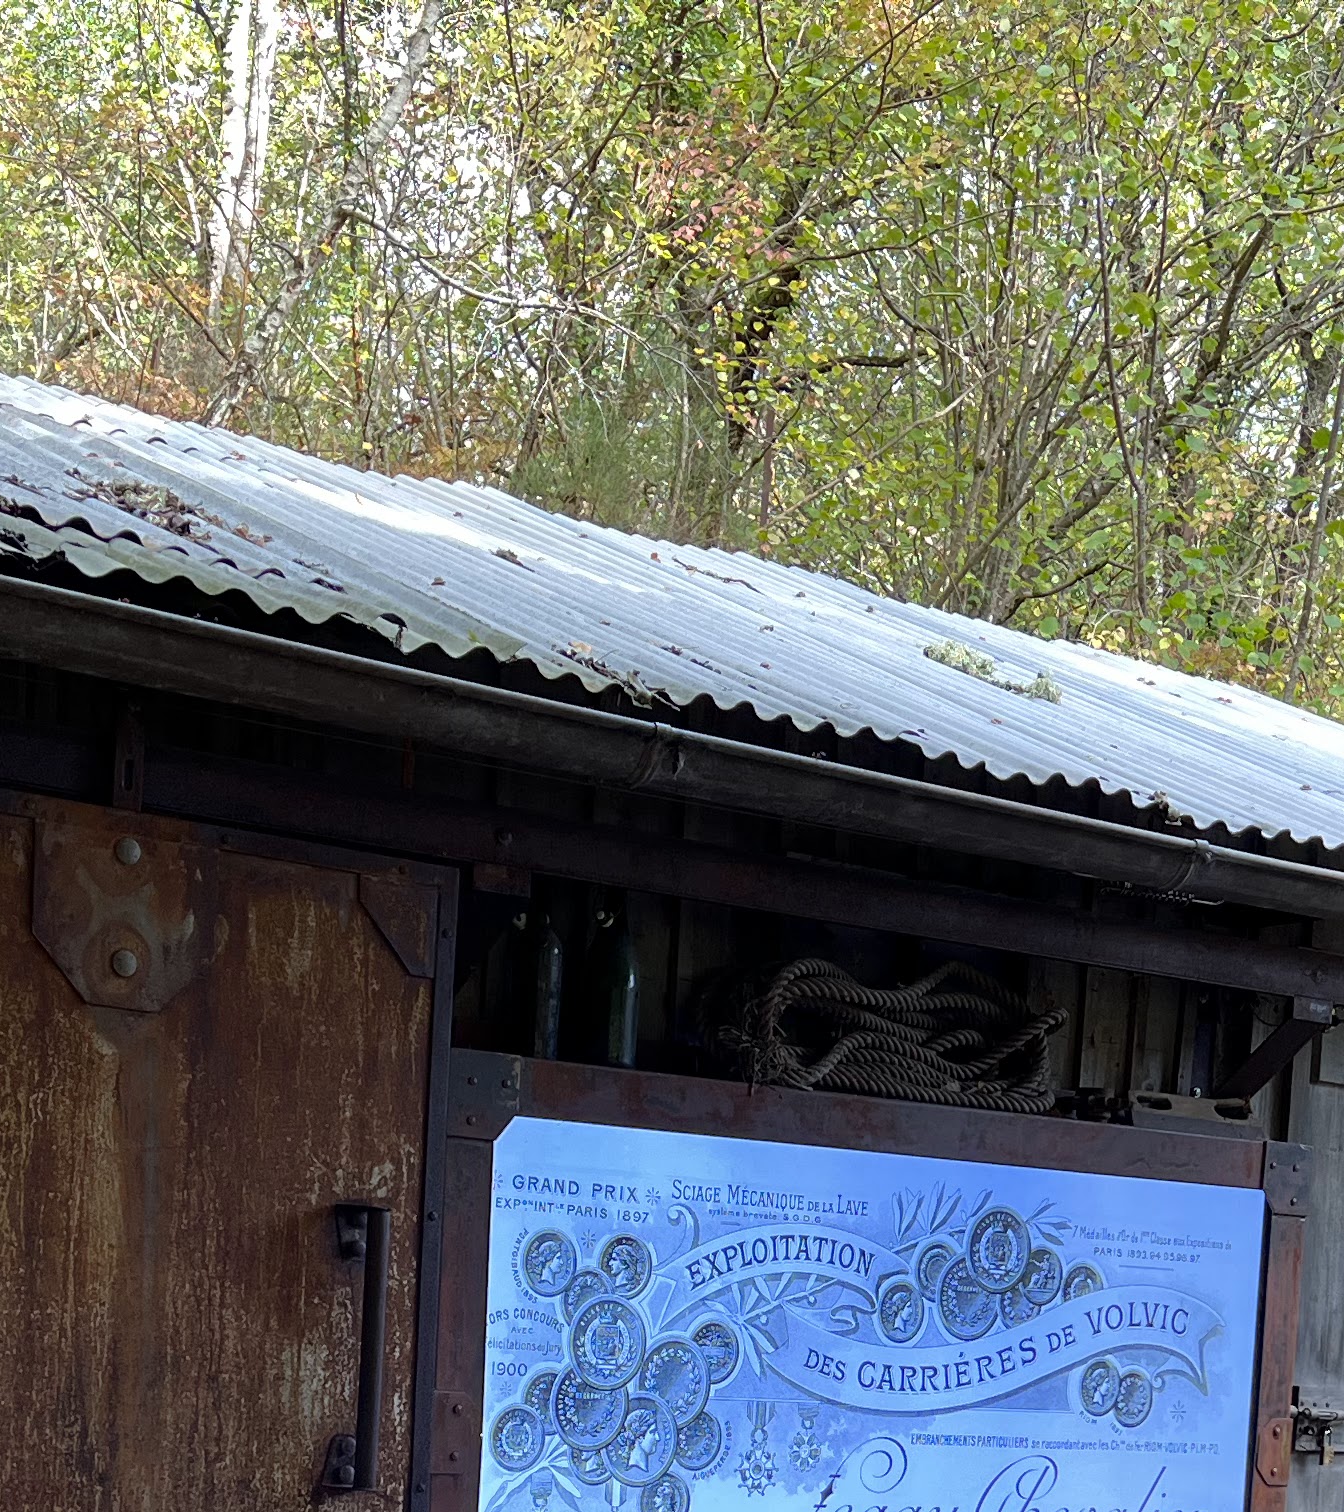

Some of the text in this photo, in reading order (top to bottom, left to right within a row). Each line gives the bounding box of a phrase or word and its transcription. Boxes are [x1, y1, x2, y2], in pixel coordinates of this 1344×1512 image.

[512, 1174, 640, 1203] GRAND PRIX
[671, 1179, 869, 1216] SCIAGE MÉCANIQUE DE LA LAVE
[567, 1205, 608, 1218] PARIS
[617, 1210, 649, 1223] 1897
[1093, 1246, 1122, 1258] PARIS
[685, 1235, 875, 1291] EXPLOITATION
[487, 1309, 509, 1324] ORS
[513, 1308, 564, 1333] CONCOURS
[487, 1337, 536, 1351] élicitations
[804, 1347, 846, 1382] DES
[1046, 1324, 1077, 1354] DE
[1084, 1302, 1189, 1336] VOLVIC
[492, 1361, 527, 1376] 1900
[910, 1433, 976, 1447] EMBRANCHEMENTS
[977, 1435, 1029, 1449] PARTICULIERS
